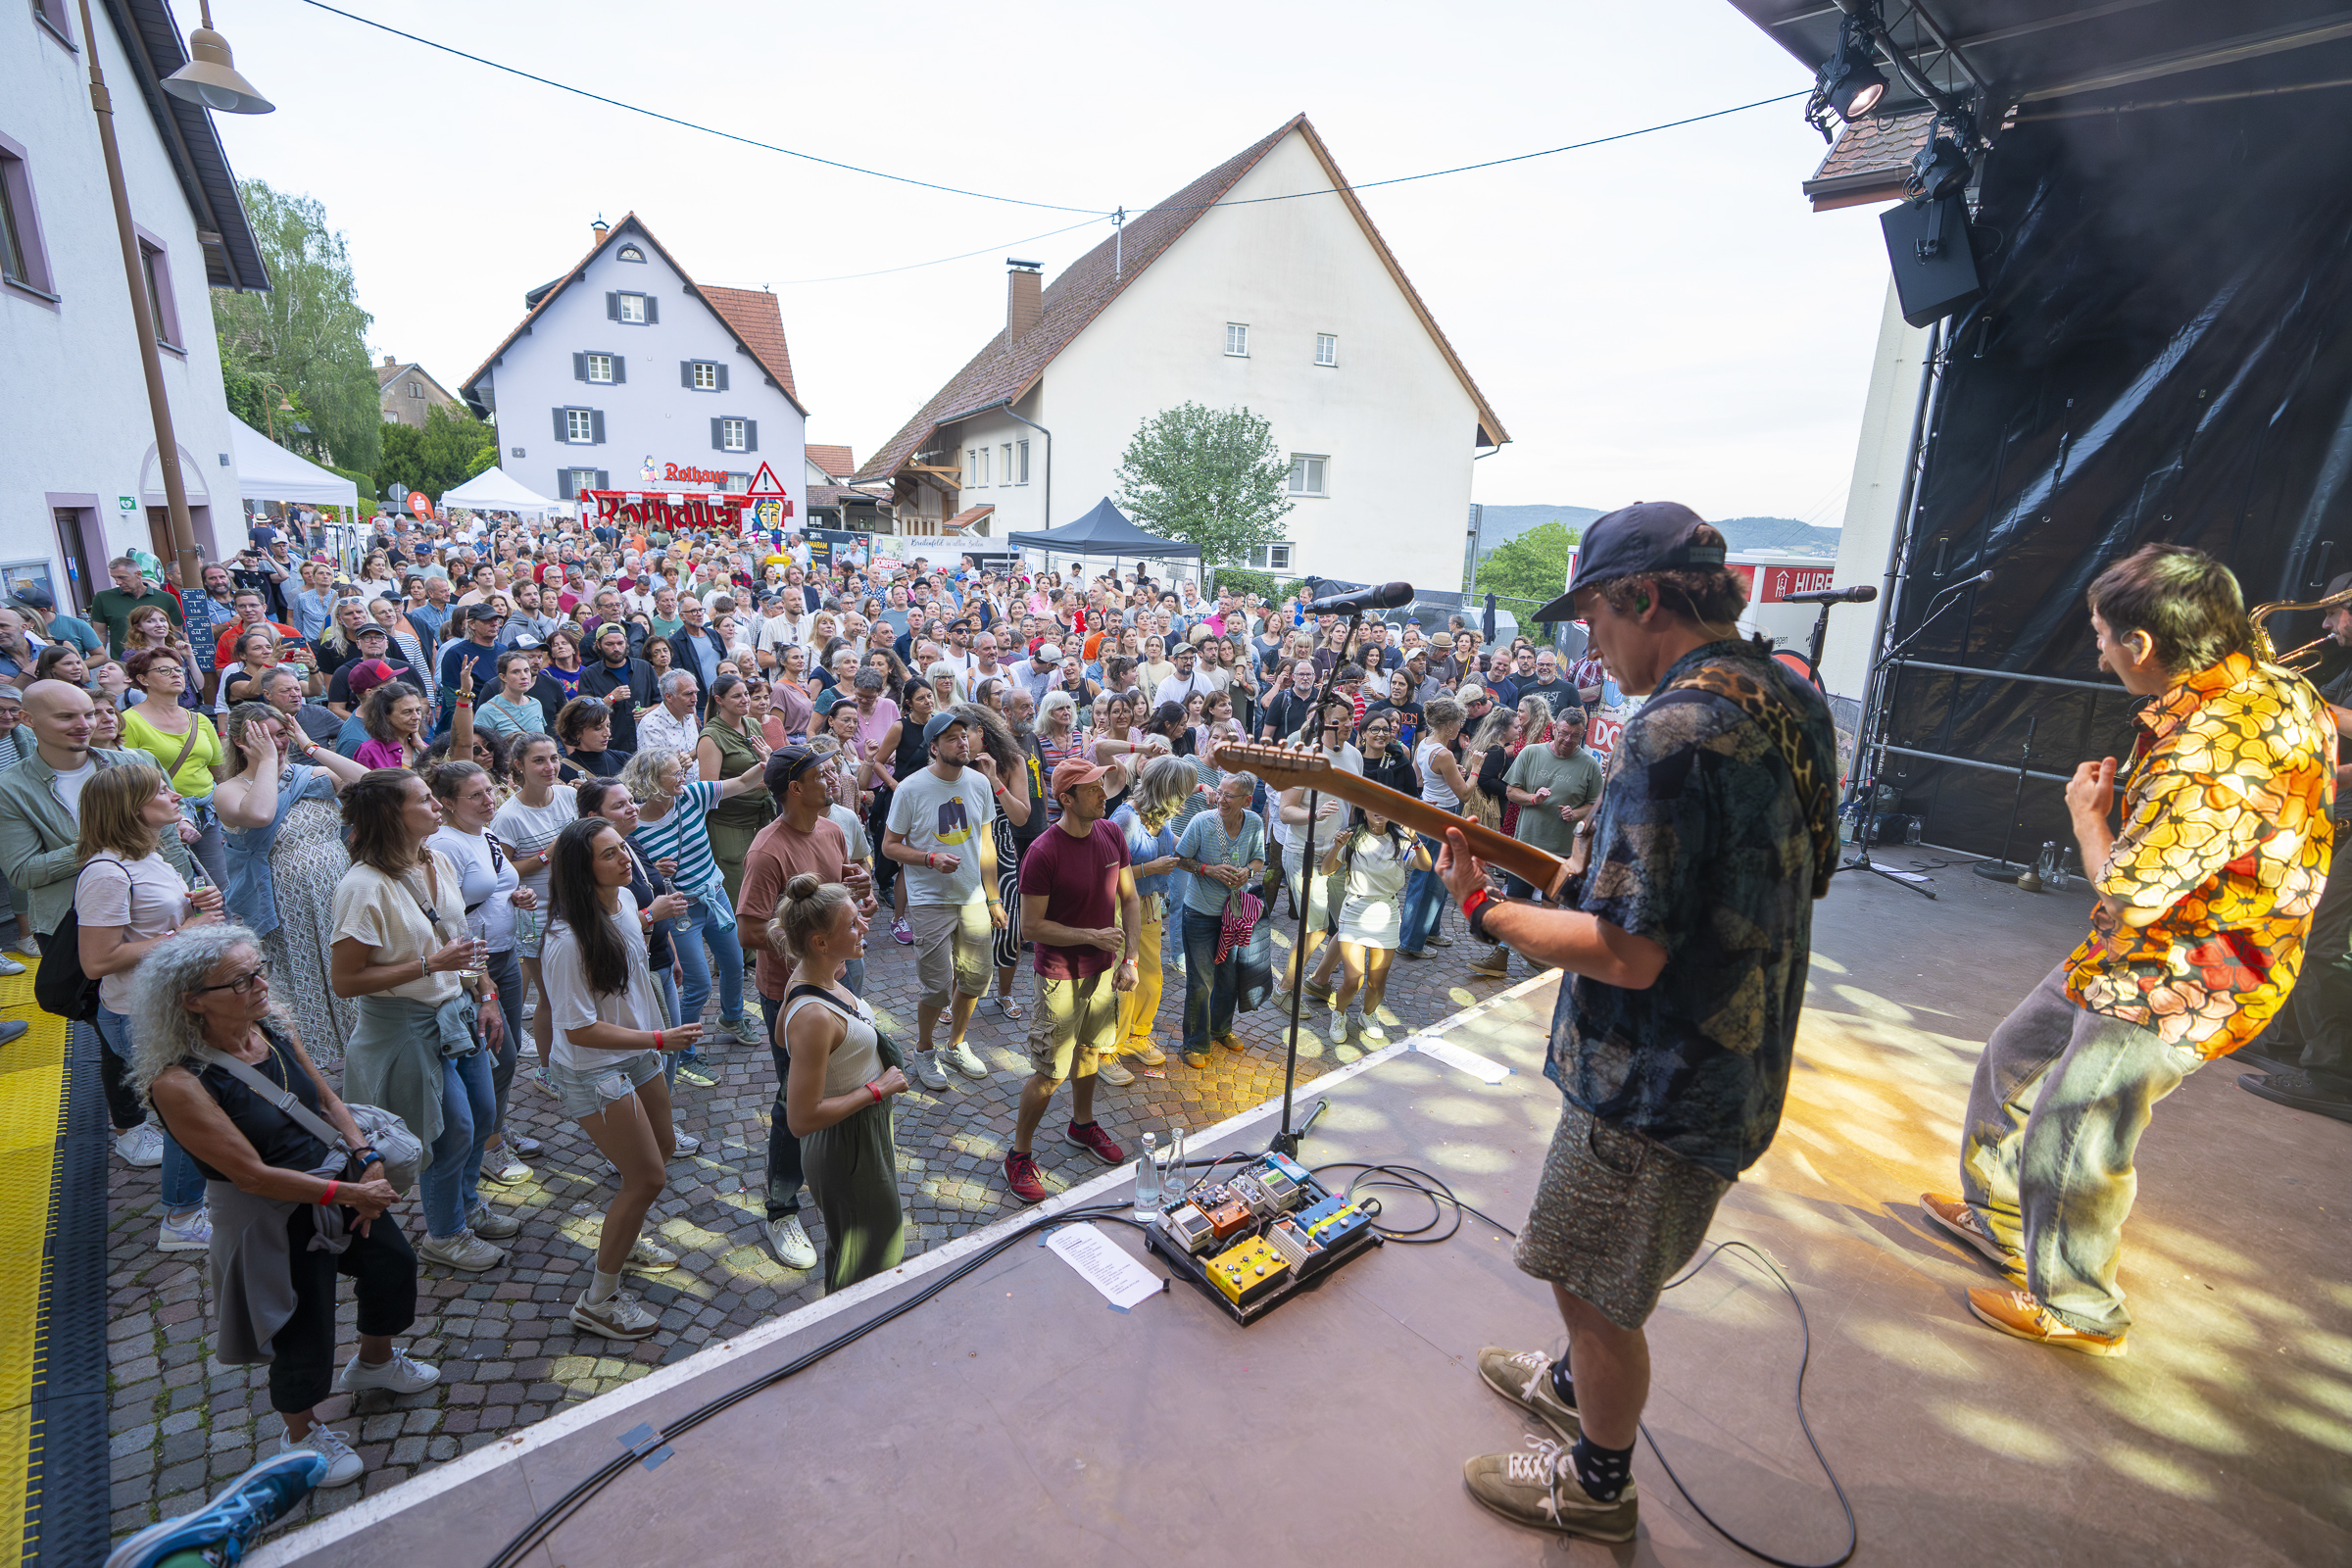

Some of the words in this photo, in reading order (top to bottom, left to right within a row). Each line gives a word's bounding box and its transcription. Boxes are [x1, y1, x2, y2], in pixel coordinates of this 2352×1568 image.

[663, 462, 728, 485] Rothaus
[599, 497, 733, 532] Rothaus
[910, 538, 945, 548] Breitenfeld
[873, 558, 903, 569] DORFFEST
